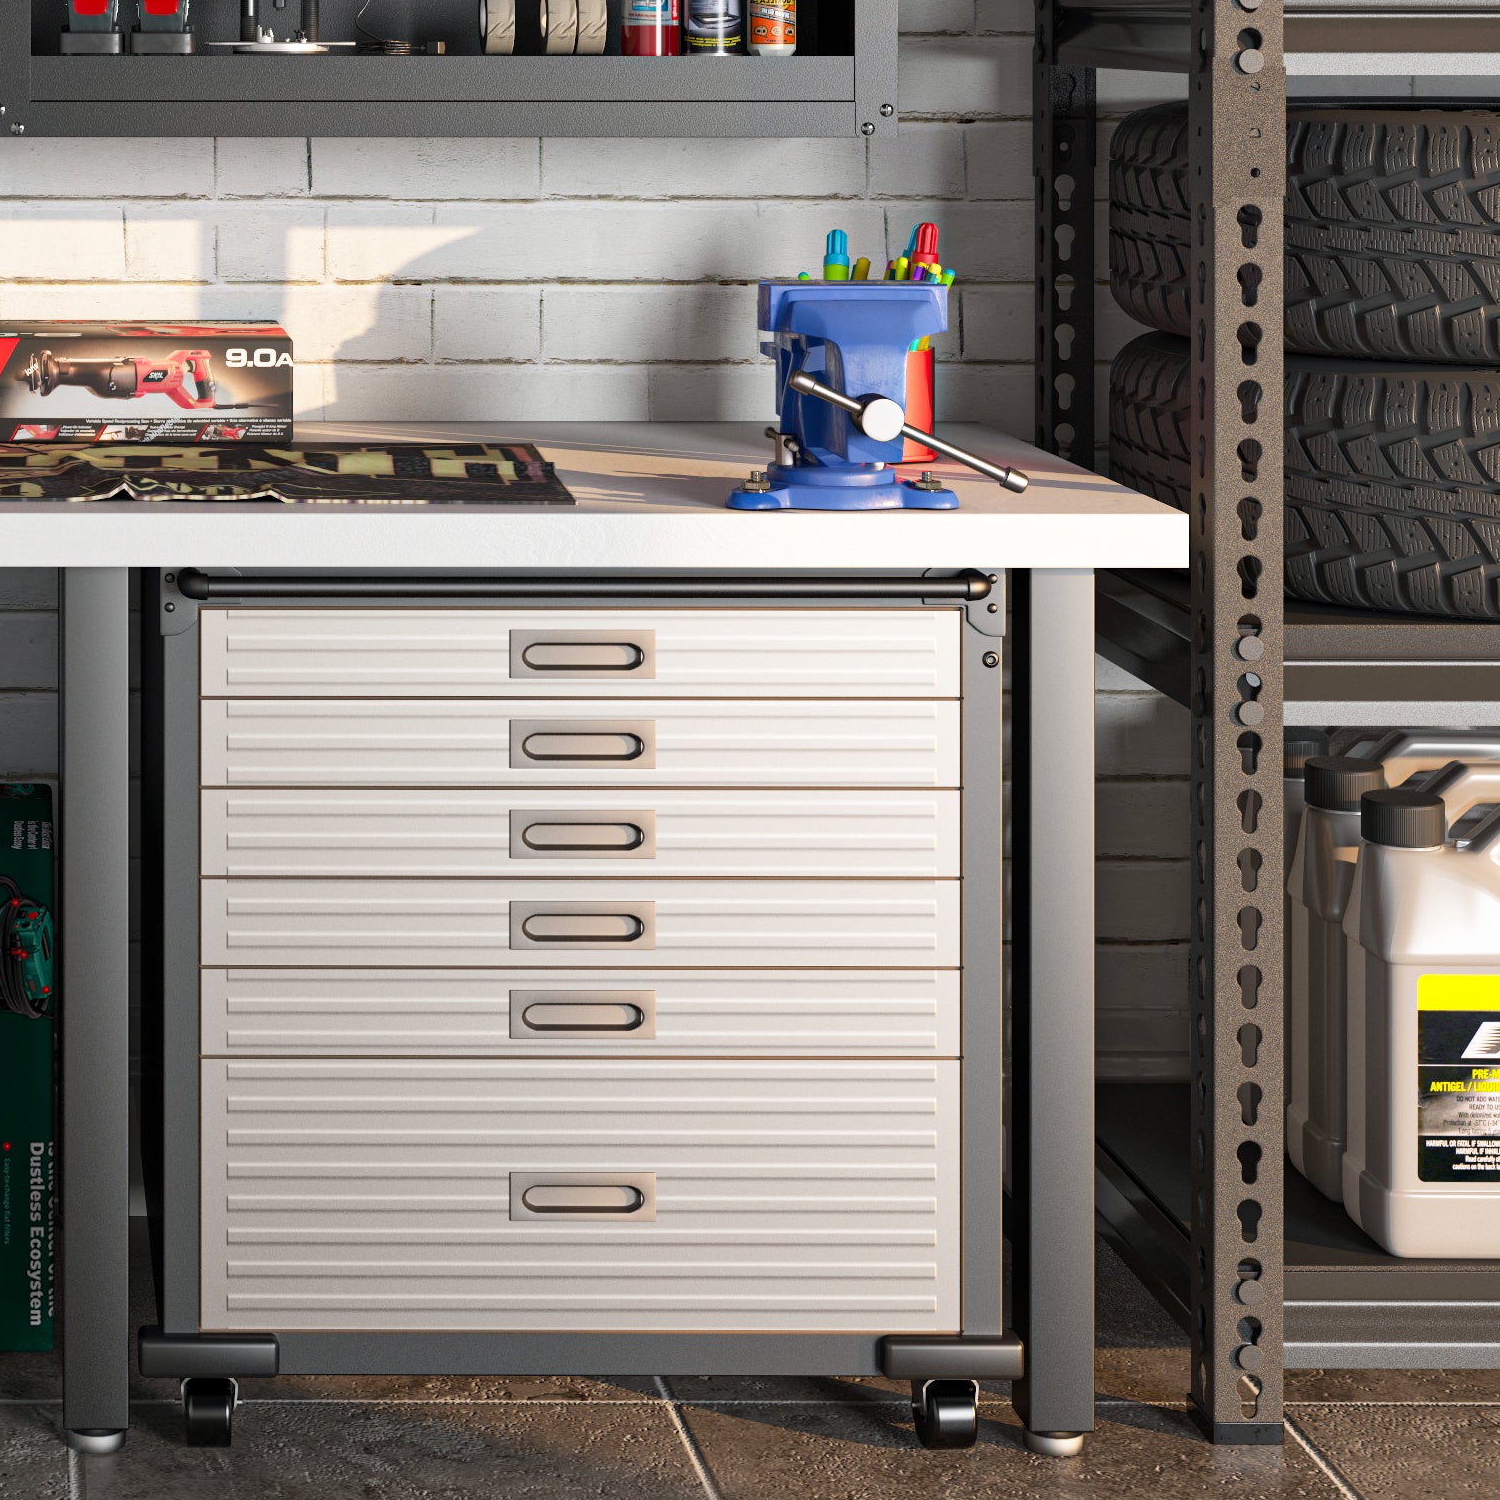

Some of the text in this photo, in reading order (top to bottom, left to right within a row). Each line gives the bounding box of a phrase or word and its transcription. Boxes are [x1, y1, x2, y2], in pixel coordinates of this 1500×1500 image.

[225, 348, 293, 368] 9.0A
[27, 1141, 45, 1326] Dustless Ecosystem
